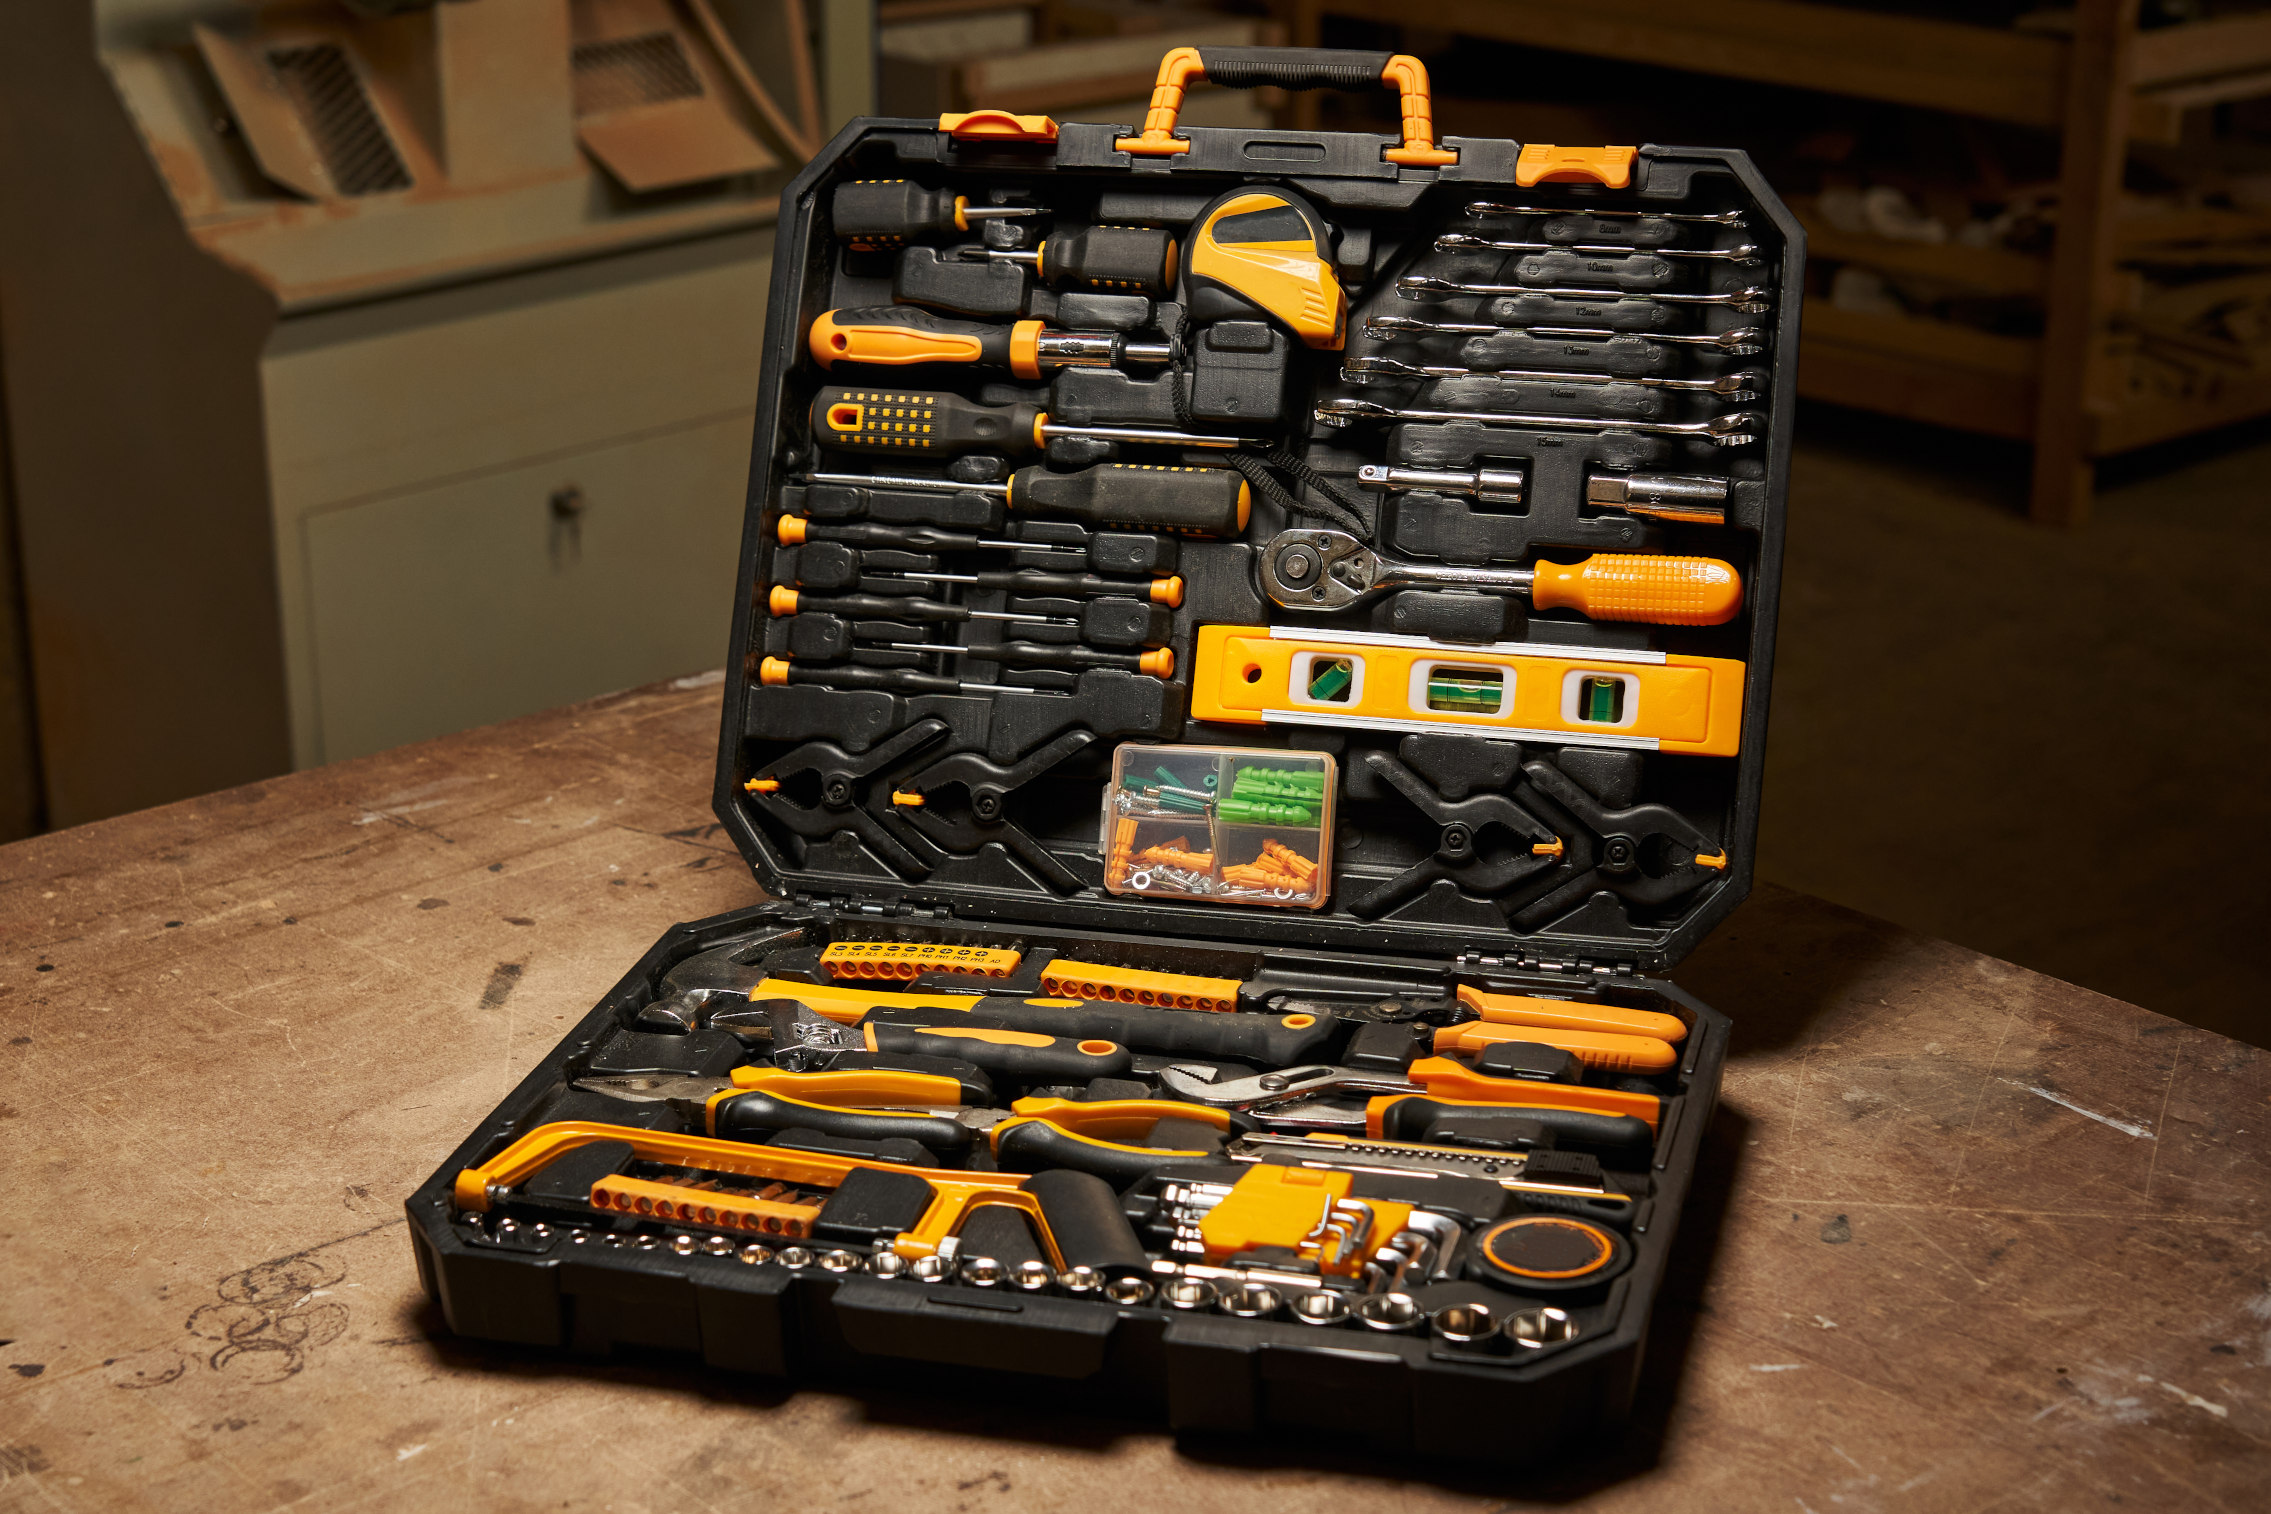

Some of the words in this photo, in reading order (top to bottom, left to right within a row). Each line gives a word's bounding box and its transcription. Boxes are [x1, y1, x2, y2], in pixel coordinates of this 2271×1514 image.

[1599, 223, 1622, 235] 8mm
[1587, 260, 1614, 273] 10mm
[1576, 305, 1602, 317] 12mm
[1563, 344, 1590, 356] 13mm
[1550, 387, 1576, 399] 14mm
[1537, 436, 1564, 448] 15mm
